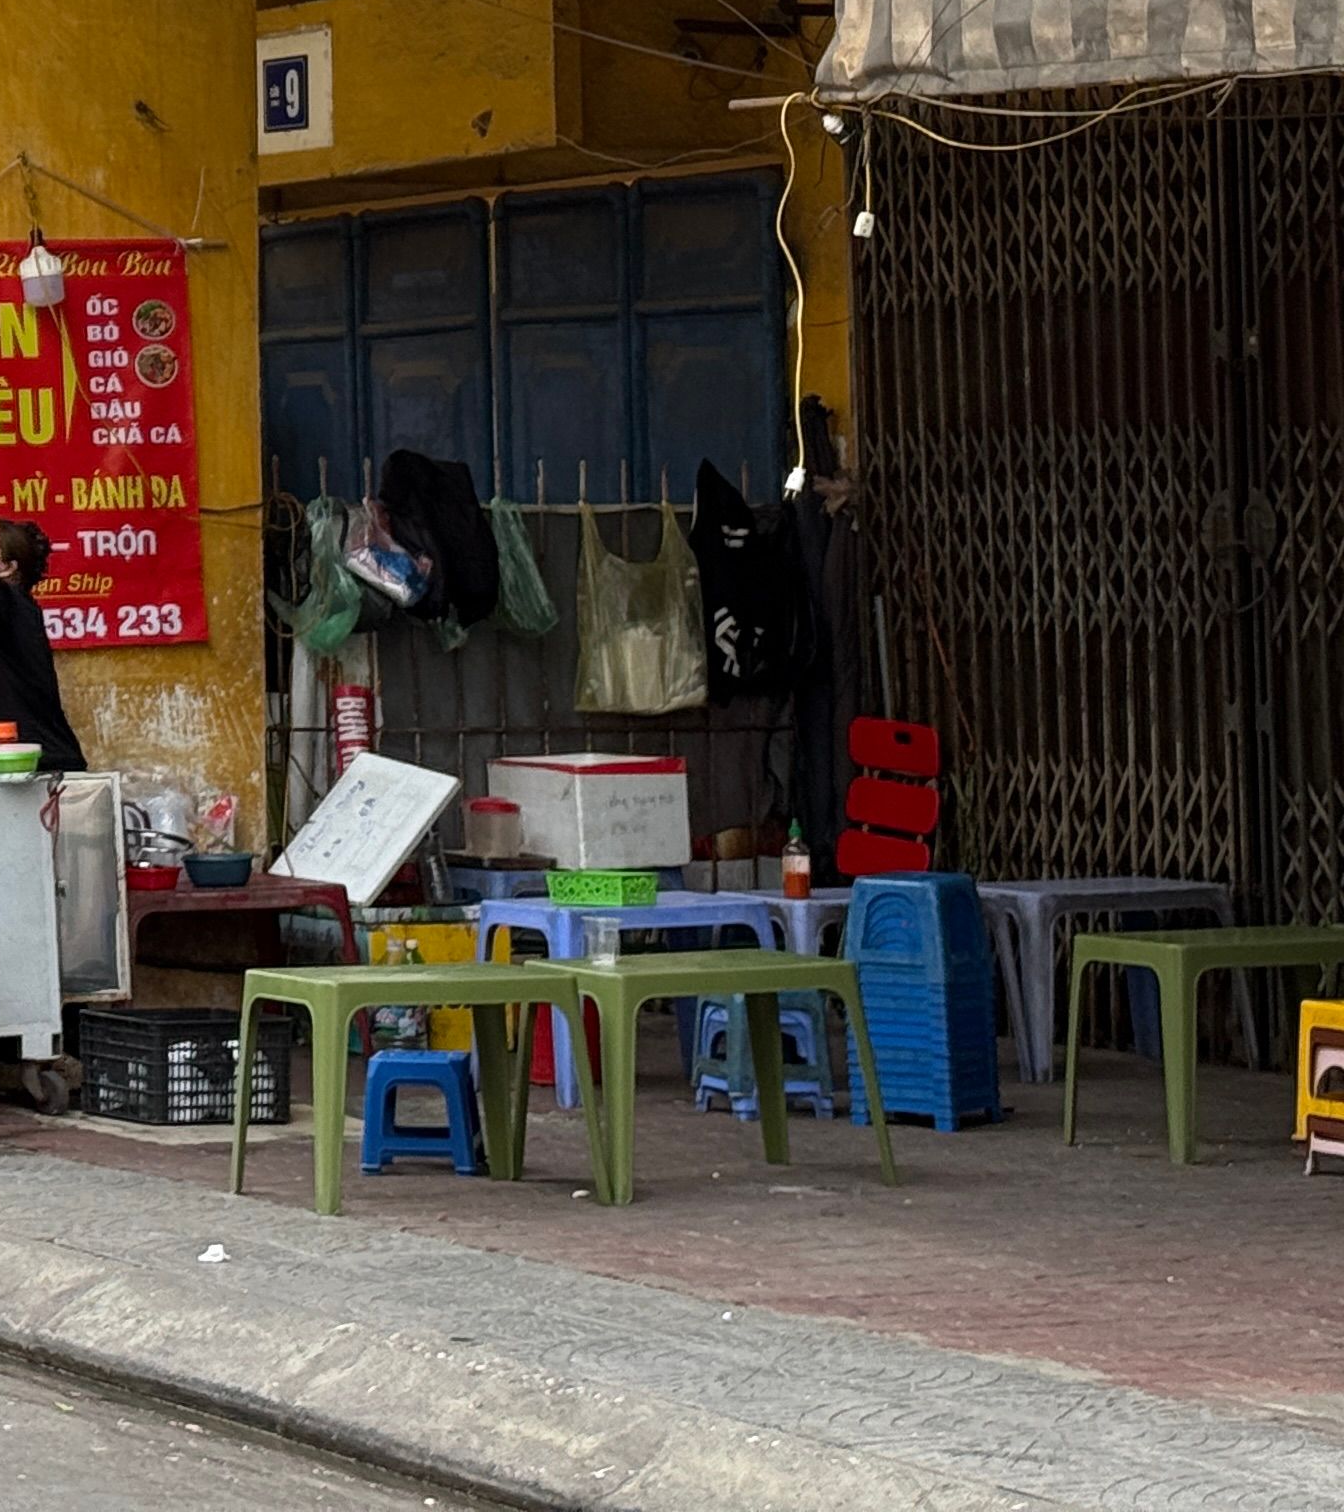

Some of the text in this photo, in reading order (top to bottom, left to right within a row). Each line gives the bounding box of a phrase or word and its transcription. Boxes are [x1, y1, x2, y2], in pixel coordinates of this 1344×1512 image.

[285, 69, 300, 118] 9
[86, 293, 120, 316] ỐC
[86, 321, 120, 342] BÒ
[89, 372, 124, 393] CÁ
[149, 422, 183, 444] CÁ
[11, 470, 48, 513] MỲ
[71, 468, 145, 511] BÁNH
[67, 572, 114, 594] Ship
[42, 603, 182, 639] 534 233
